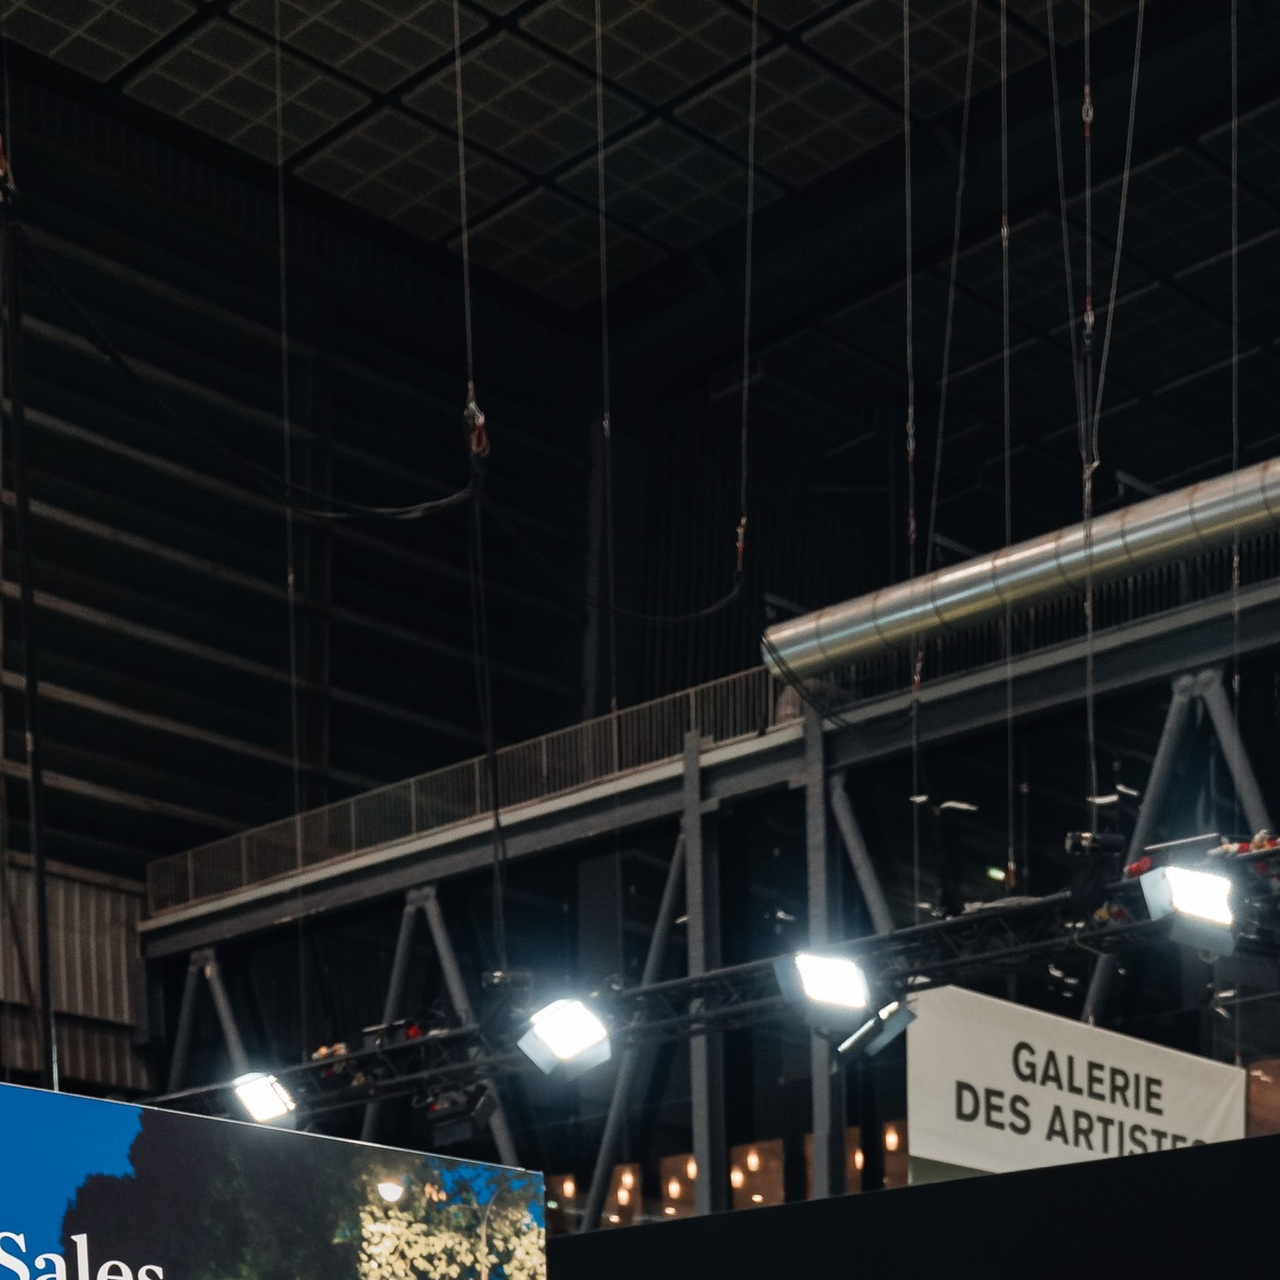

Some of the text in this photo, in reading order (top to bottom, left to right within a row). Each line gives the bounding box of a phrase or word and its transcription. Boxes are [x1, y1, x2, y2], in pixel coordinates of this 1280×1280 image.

[1012, 1041, 1164, 1116] GALERIE
[954, 1080, 1207, 1156] DES ARTIST
